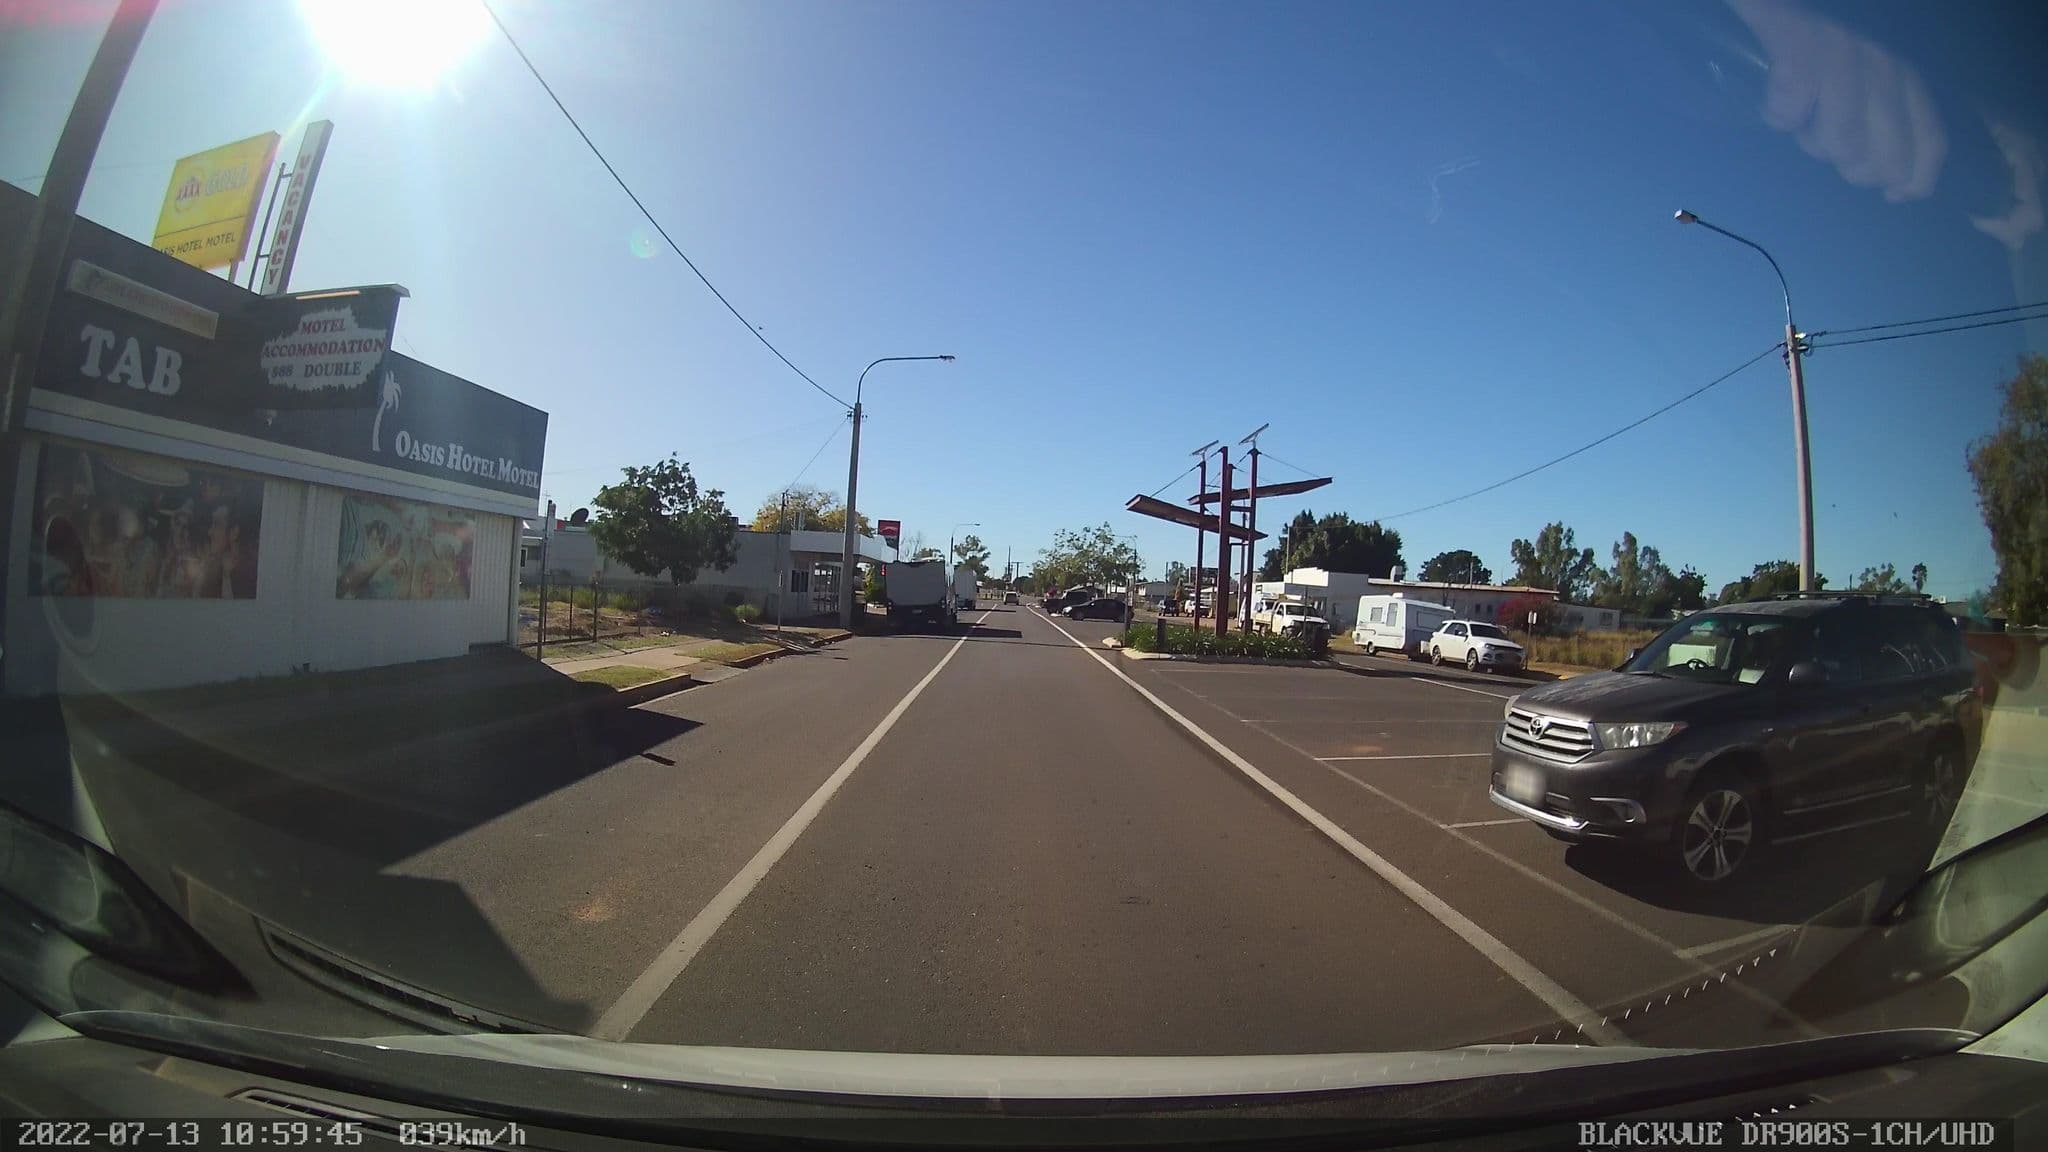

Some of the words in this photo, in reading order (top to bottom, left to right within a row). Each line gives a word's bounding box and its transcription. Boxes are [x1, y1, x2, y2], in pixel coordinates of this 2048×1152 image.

[268, 154, 311, 285] VACANCY
[177, 240, 203, 254] HOTEL
[205, 232, 236, 248] MOTEL
[302, 318, 346, 334] MOTEL
[262, 338, 386, 358] ACCOMMODATION
[79, 323, 183, 396] TAB
[304, 361, 362, 378] DOUBLE
[395, 430, 445, 466] OASIS
[446, 442, 496, 479] HOTEL
[497, 457, 540, 489] MOTEL
